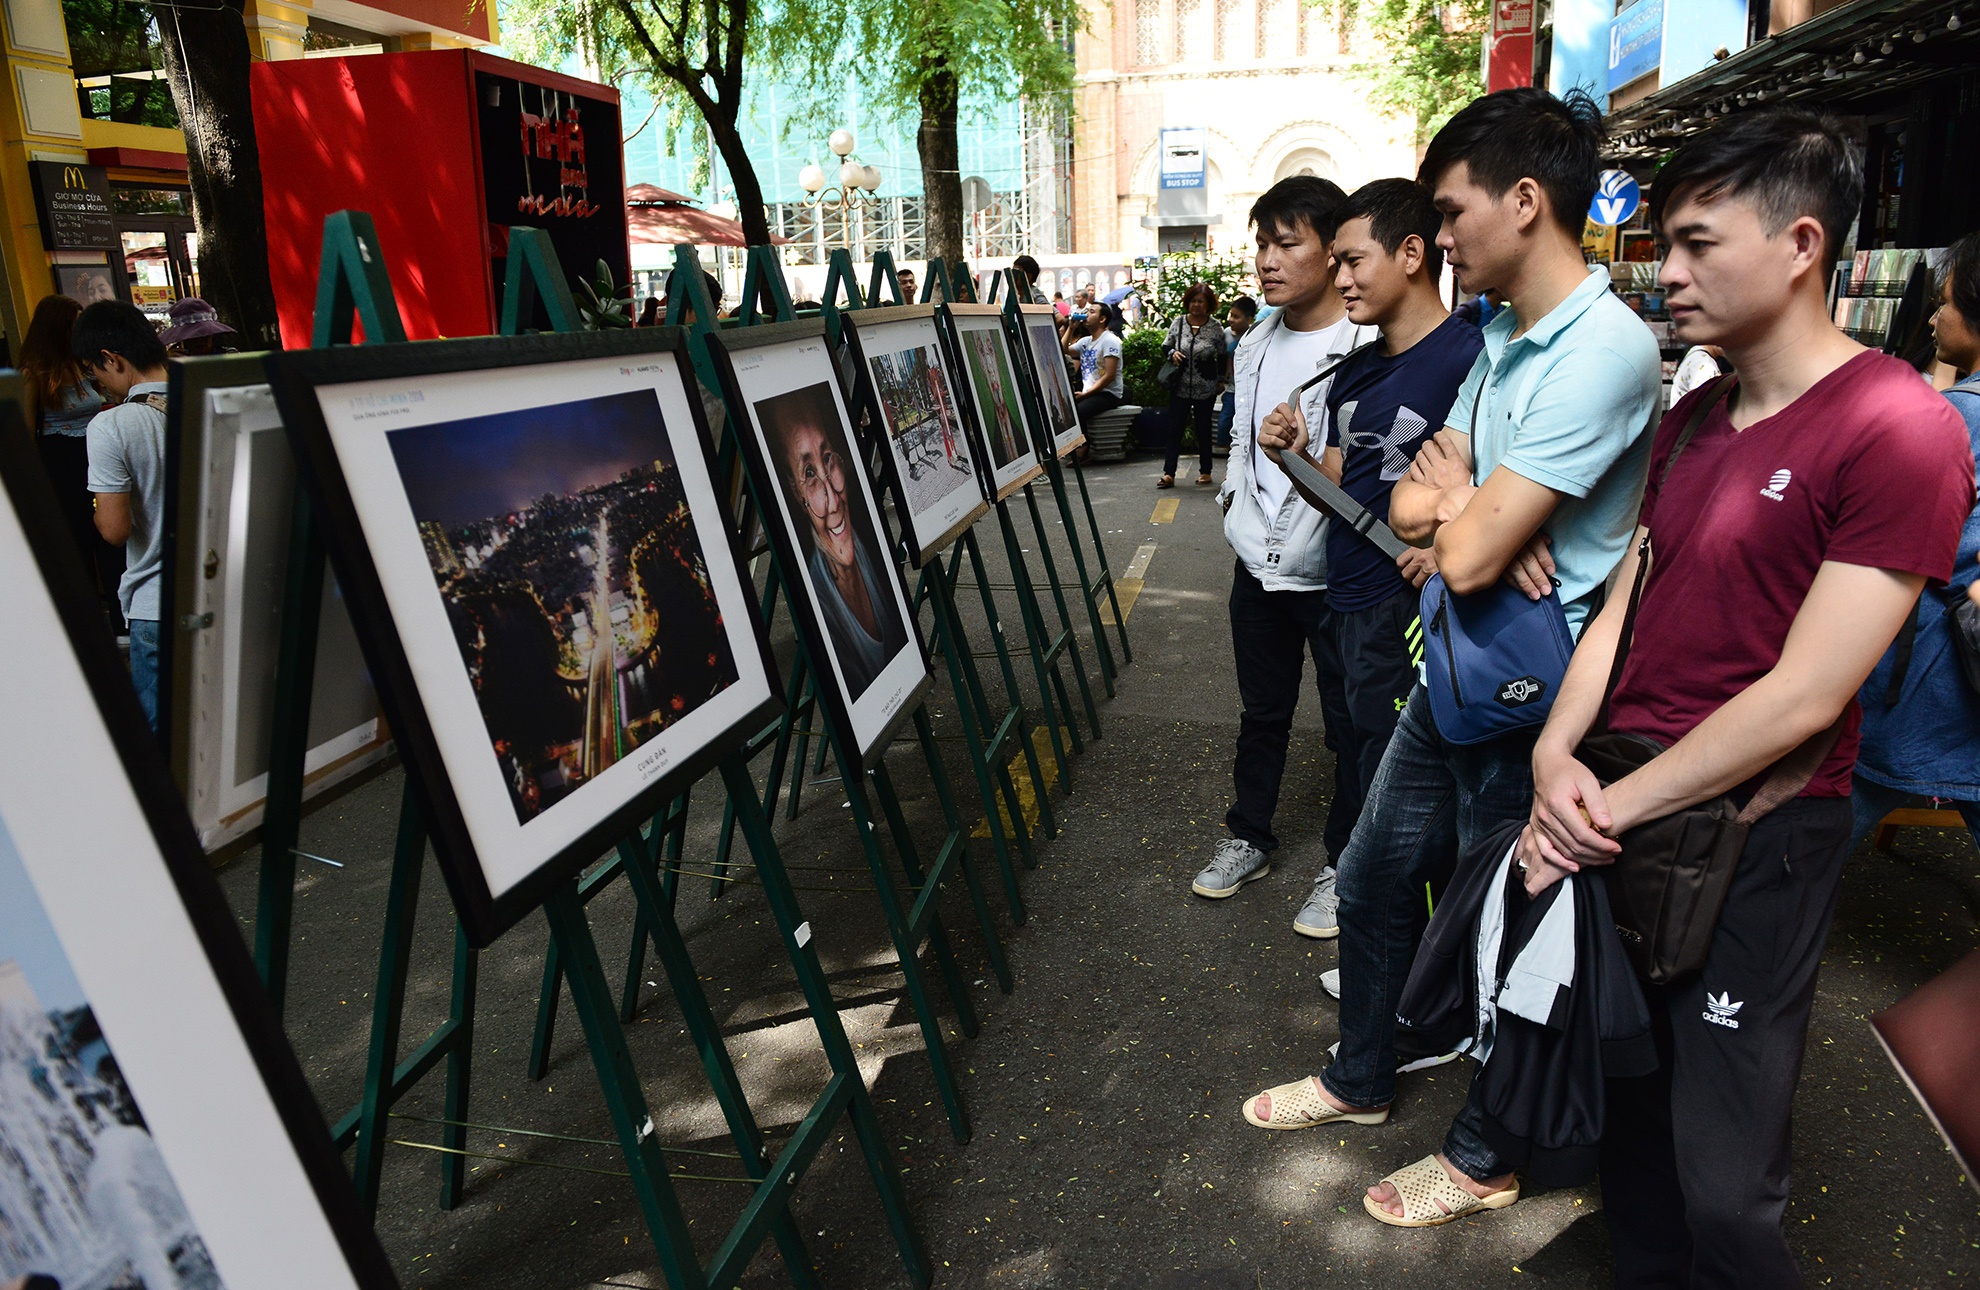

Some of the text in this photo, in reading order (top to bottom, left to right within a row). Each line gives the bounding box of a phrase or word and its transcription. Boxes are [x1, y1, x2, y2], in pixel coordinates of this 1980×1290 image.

[1166, 178, 1200, 187] BUS STOP
[52, 200, 108, 212] Business Hours
[637, 755, 654, 772] CUNG
[1702, 1011, 1739, 1029] adidas
